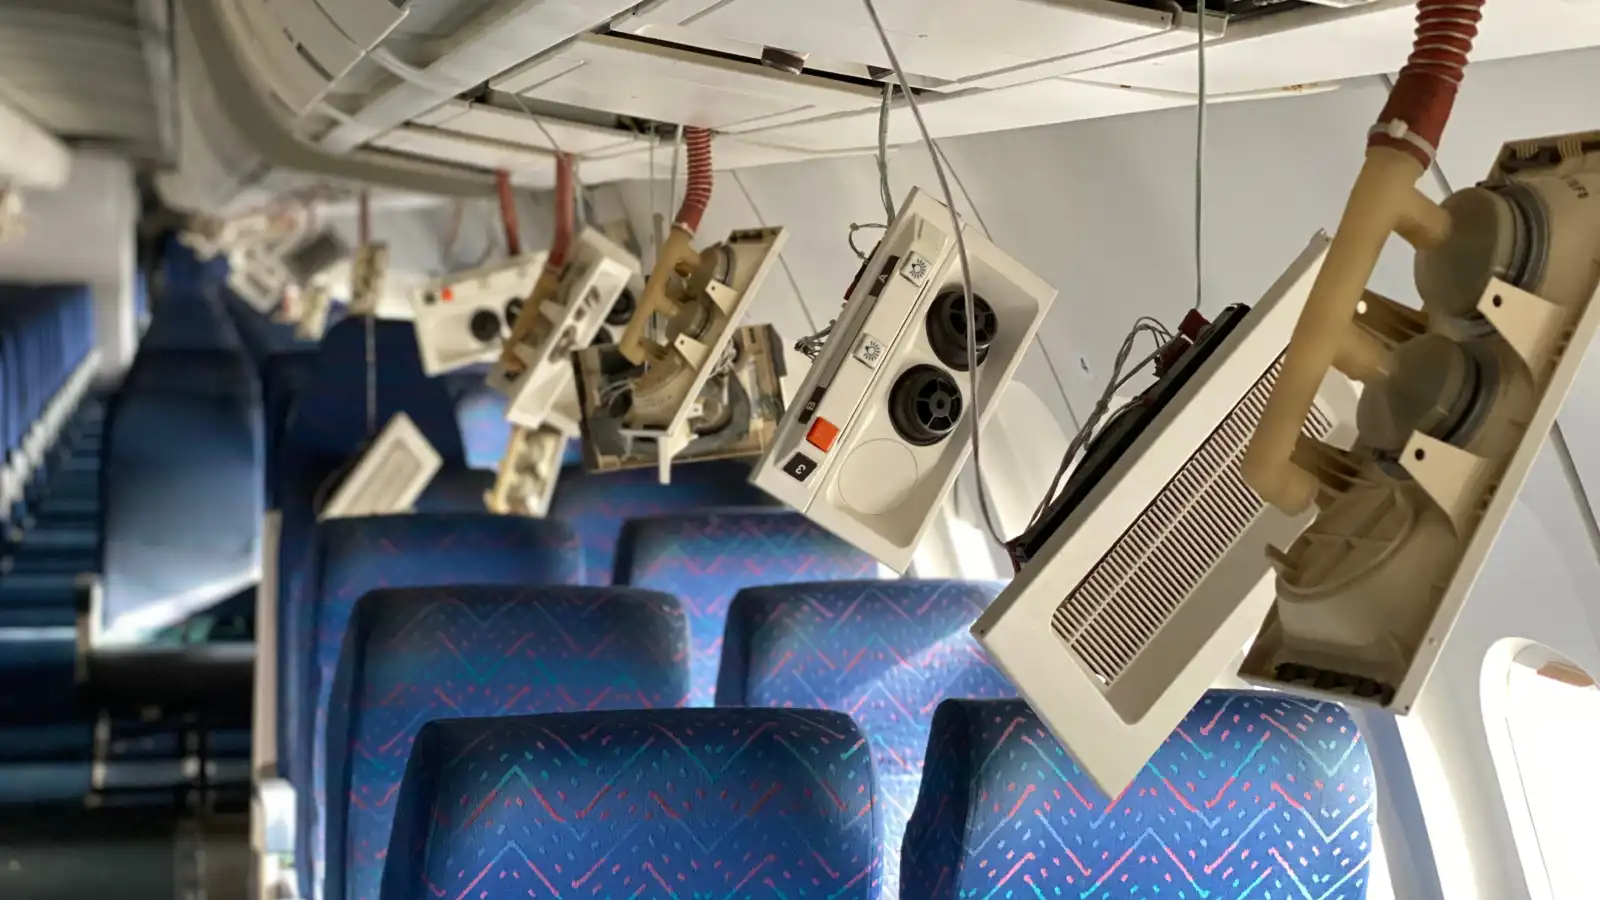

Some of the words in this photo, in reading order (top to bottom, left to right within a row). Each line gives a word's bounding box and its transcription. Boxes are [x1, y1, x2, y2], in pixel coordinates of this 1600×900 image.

[879, 274, 889, 284] A
[806, 401, 816, 411] B
[795, 464, 806, 474] 3
